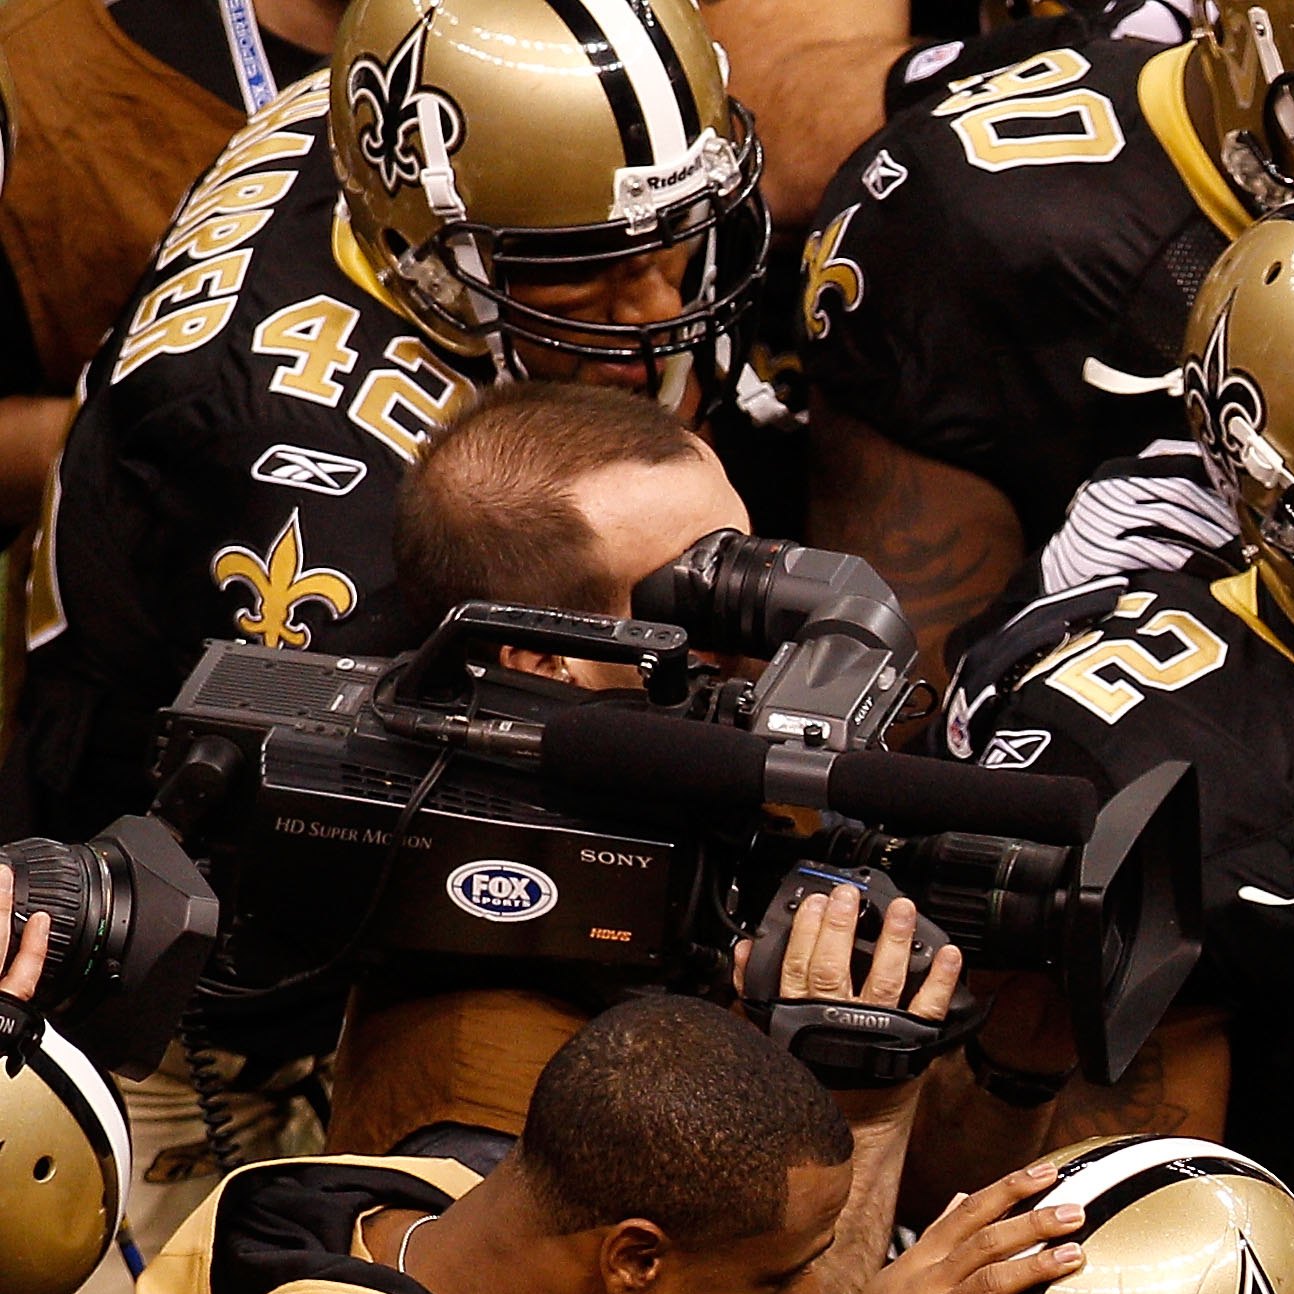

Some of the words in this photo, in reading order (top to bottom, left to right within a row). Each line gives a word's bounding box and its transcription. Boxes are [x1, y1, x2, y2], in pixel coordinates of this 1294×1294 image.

[251, 294, 480, 463] 42
[275, 816, 305, 834] HD
[308, 822, 358, 843] SUPER
[580, 848, 654, 870] SONY
[471, 873, 531, 901] FOX
[471, 896, 532, 909] SPORTS
[822, 1007, 891, 1029] Canon
